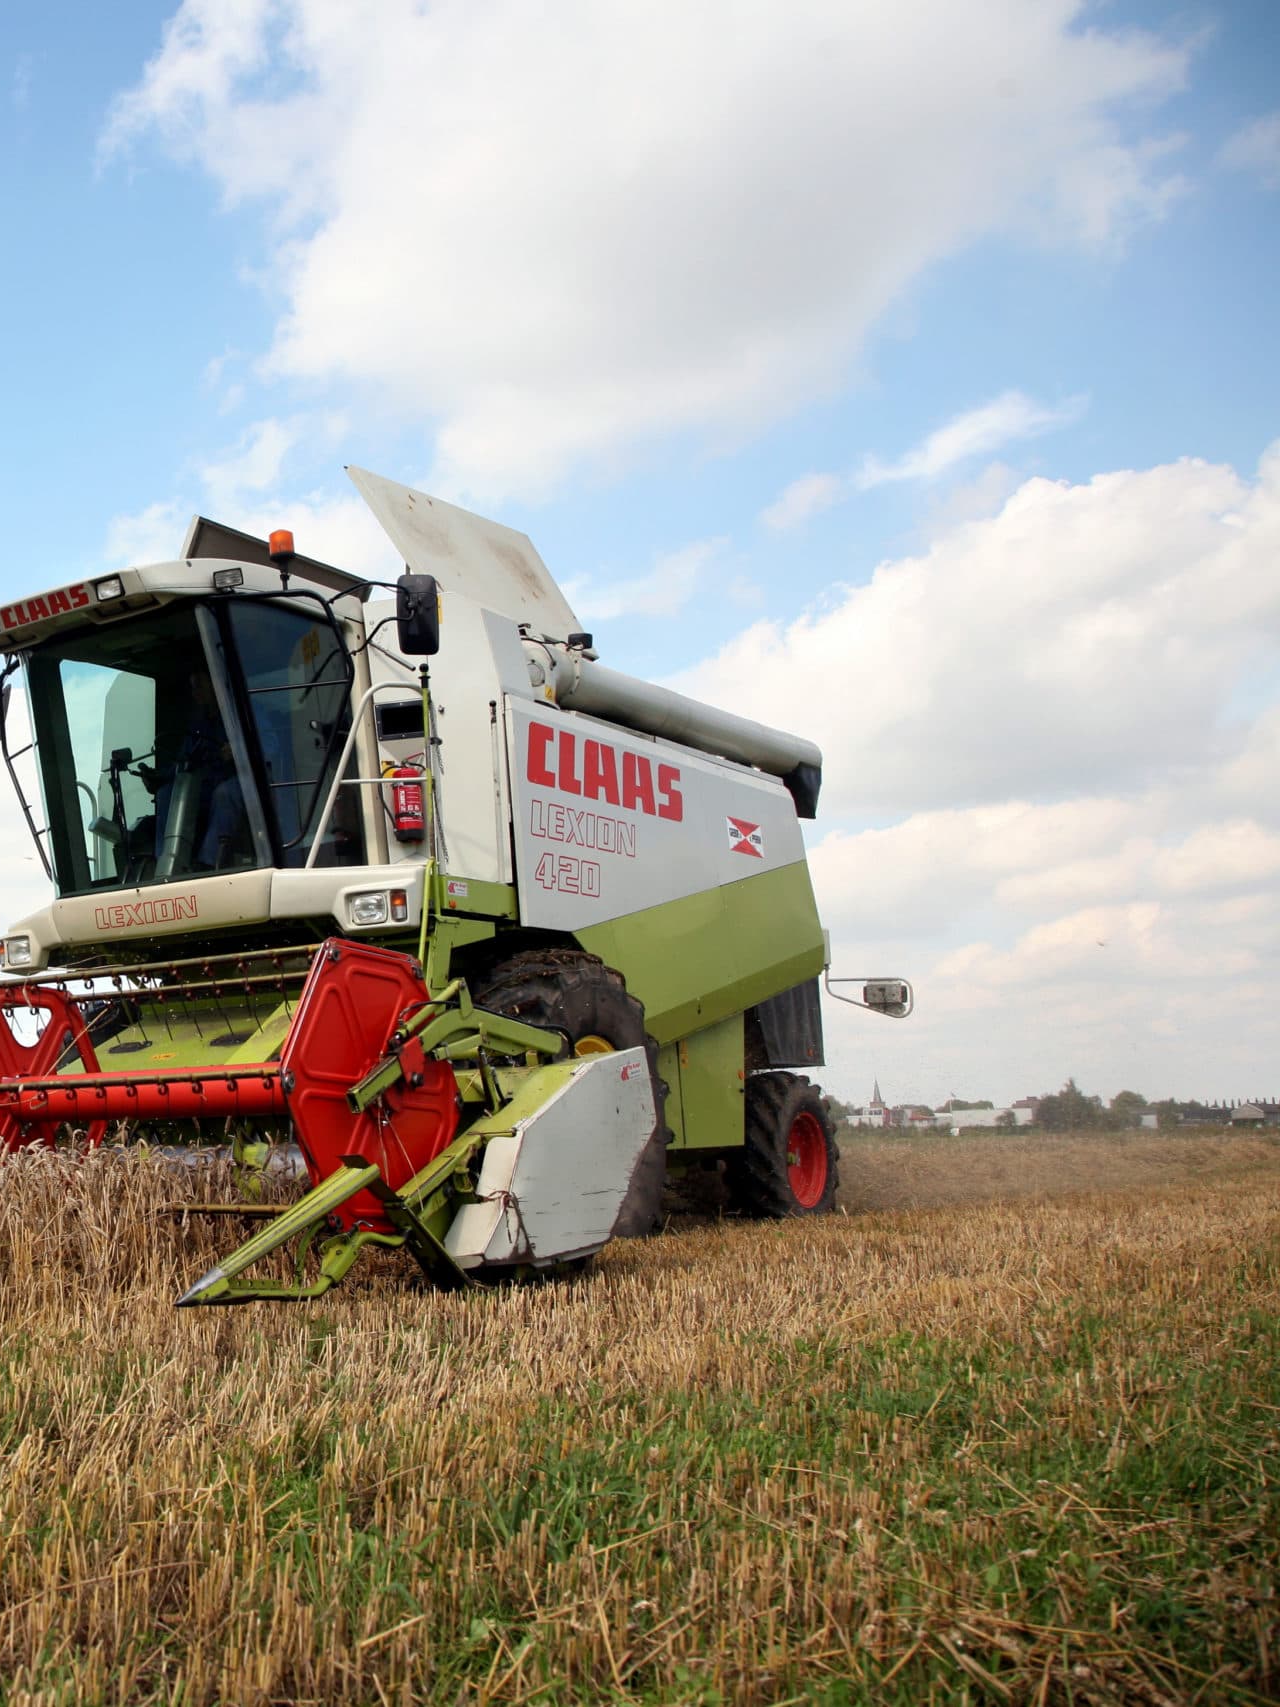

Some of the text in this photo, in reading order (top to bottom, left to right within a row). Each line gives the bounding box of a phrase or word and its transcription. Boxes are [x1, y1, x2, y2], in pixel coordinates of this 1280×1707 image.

[0, 583, 90, 630] CLAAS
[527, 721, 683, 823] CLAAS
[530, 800, 636, 858] LEXION
[535, 852, 601, 898] 420
[95, 895, 198, 930] LEXION
